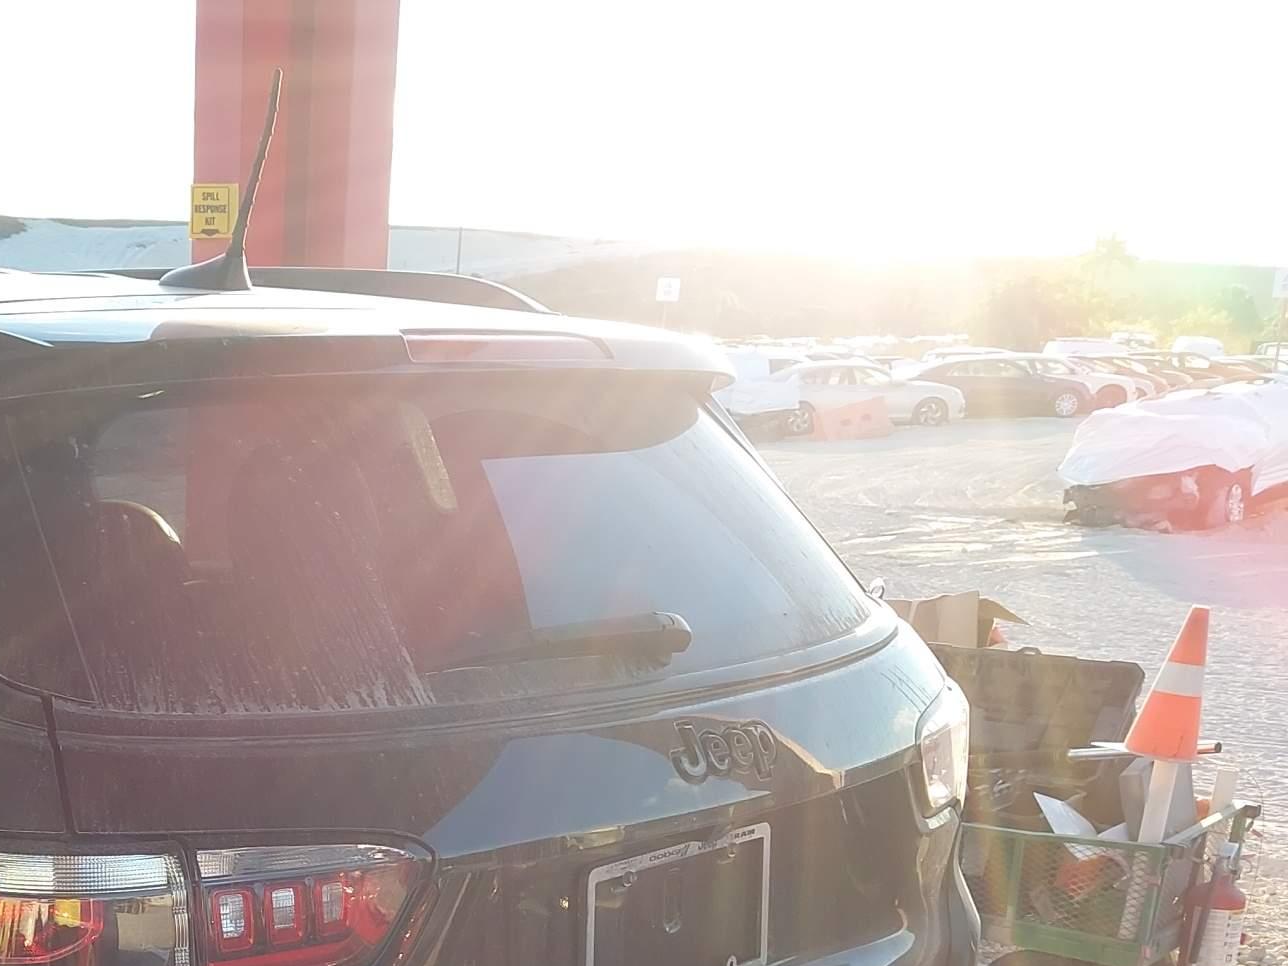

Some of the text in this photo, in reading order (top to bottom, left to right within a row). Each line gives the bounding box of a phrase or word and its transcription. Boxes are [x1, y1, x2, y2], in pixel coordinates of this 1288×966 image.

[202, 192, 220, 201] SPILL
[205, 216, 216, 225] KIT
[669, 719, 777, 785] Jeep
